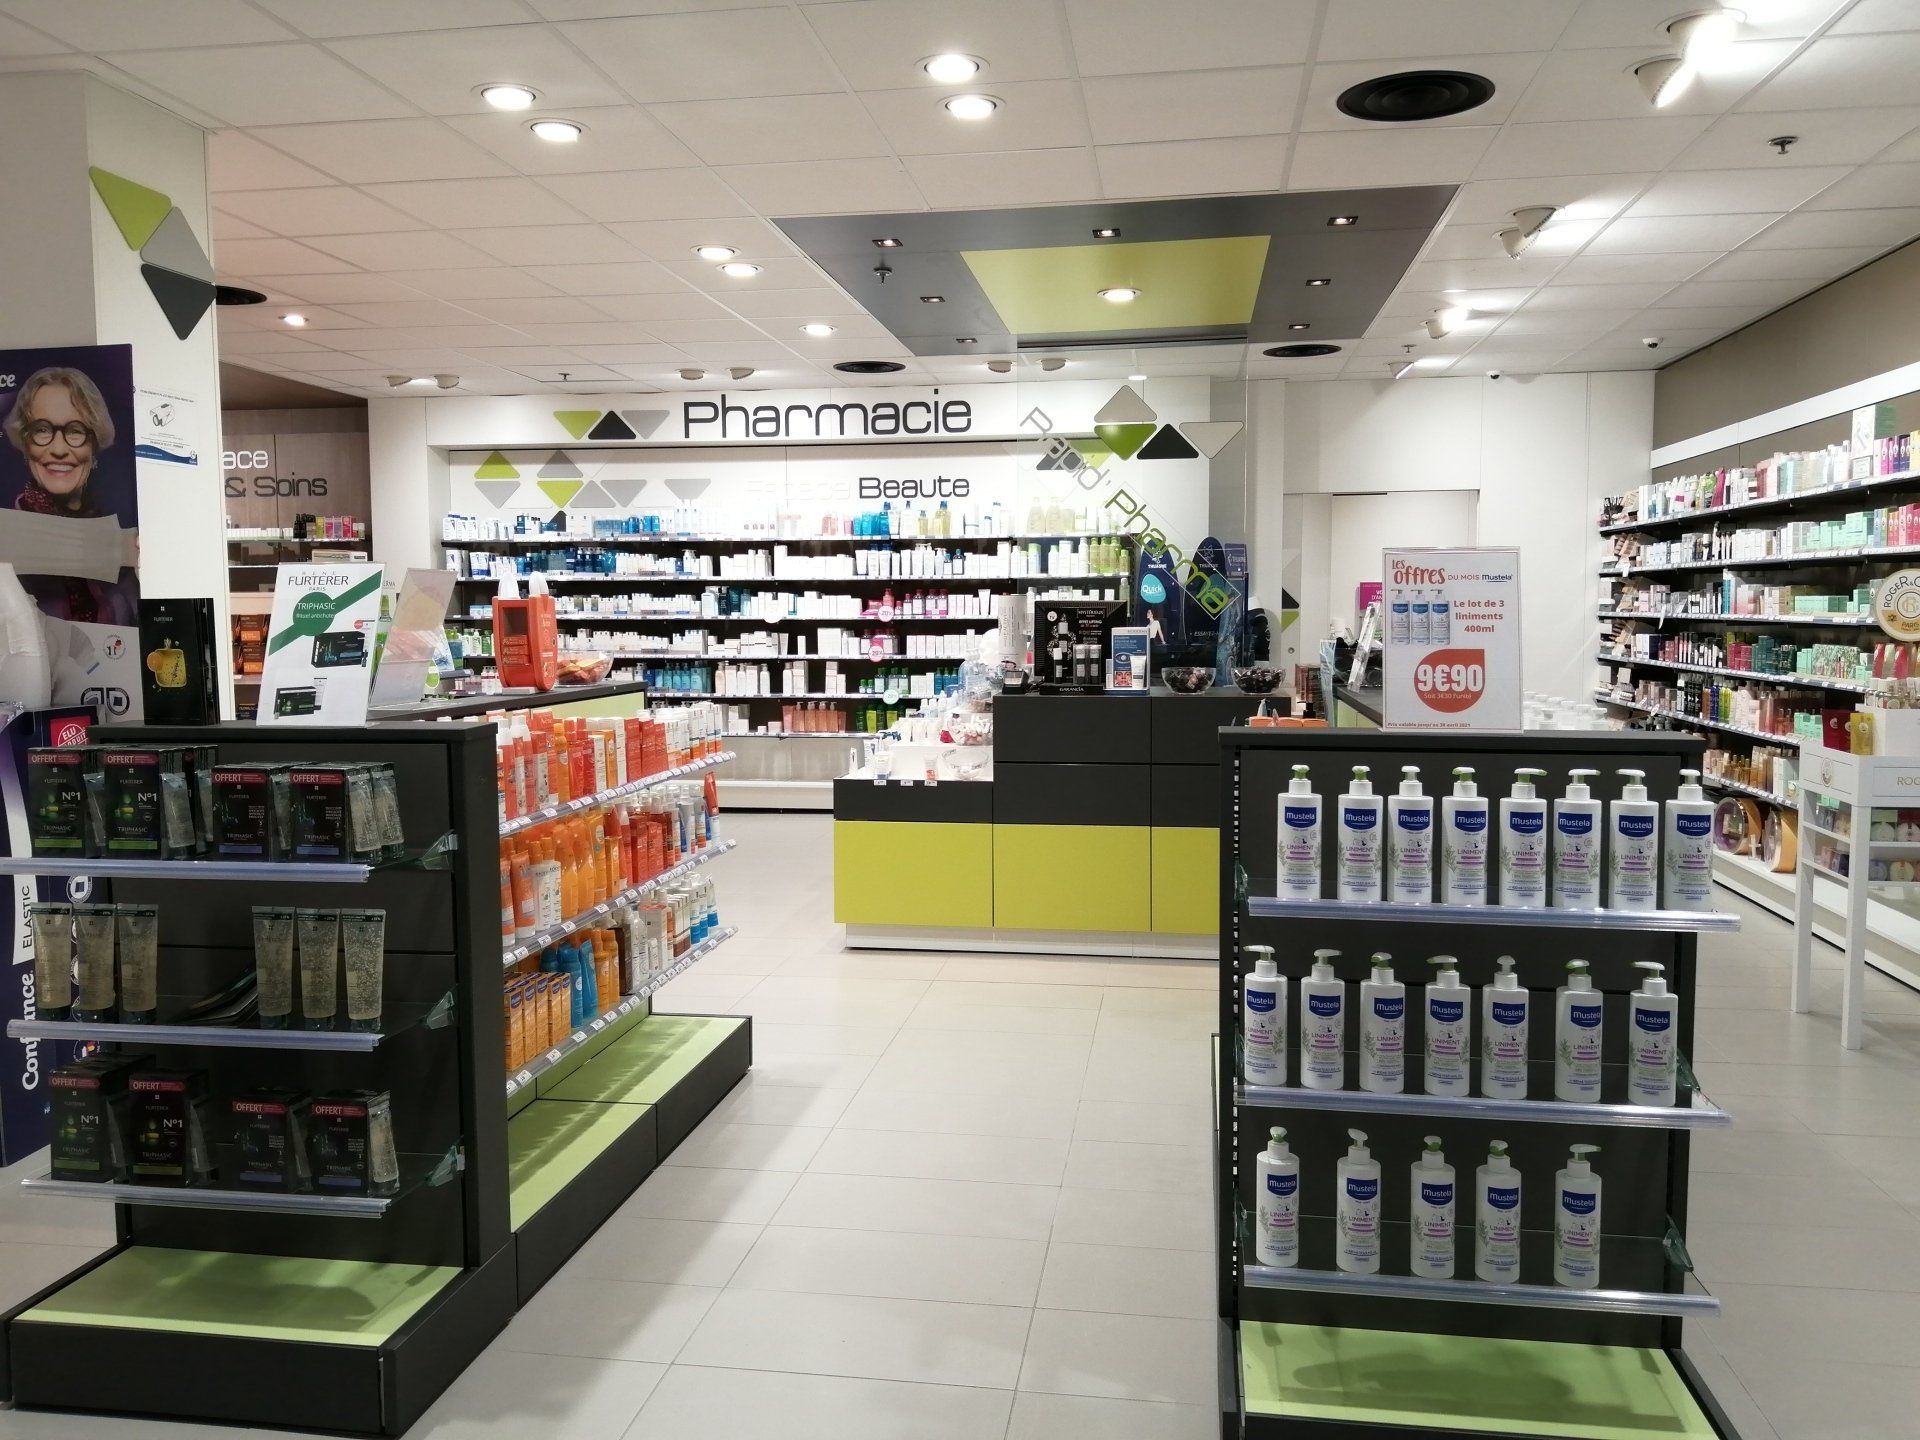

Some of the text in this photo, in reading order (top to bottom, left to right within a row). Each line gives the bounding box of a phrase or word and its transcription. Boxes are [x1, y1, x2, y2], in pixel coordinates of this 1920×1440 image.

[683, 388, 972, 439] Pharmacie
[254, 471, 328, 497] Soins
[858, 475, 970, 499] Beaute
[1104, 489, 1229, 614] Pharma
[1393, 565, 1446, 586] offres
[288, 575, 349, 586] FURTERER
[1884, 576, 1909, 608] ROGER
[297, 602, 337, 611] TRIPHASIC
[1455, 612, 1503, 620] liniments
[1464, 625, 1495, 633] 400ml
[1417, 664, 1483, 692] 9€90
[62, 727, 76, 740] ELU
[31, 755, 57, 763] OFFERT
[107, 755, 134, 764] OFFERT
[214, 773, 242, 782] OFFERT
[292, 774, 320, 783] OFFERT
[1286, 812, 1315, 820] Mustela
[1345, 814, 1375, 822] Mustela
[1400, 815, 1429, 823] Mustela
[1457, 816, 1485, 824] Mustela
[1512, 817, 1542, 825] Mustela
[1559, 818, 1591, 826] Mustela
[1620, 820, 1652, 829] Mustela
[1679, 819, 1710, 828] Mustela
[22, 885, 32, 949] ELASTIC
[1247, 995, 1274, 1005] Mustela
[1311, 1000, 1340, 1009] Mustela
[1376, 1003, 1403, 1011] Mustela
[1432, 1005, 1462, 1015] Mustela
[1494, 1008, 1525, 1016] Mustela
[1573, 1011, 1600, 1019] Mustela
[1637, 1014, 1668, 1024] Mustela
[51, 1078, 76, 1086] OFFERT
[132, 1081, 159, 1090] OFFERT
[235, 1103, 262, 1112] OFFERT
[315, 1106, 342, 1115] OFFERT
[1269, 1180, 1296, 1188] Mustela
[1348, 1183, 1377, 1192] Mustela
[1423, 1189, 1452, 1197] Mustela
[1489, 1193, 1518, 1201] Mustela
[1564, 1197, 1595, 1207] Mustela
